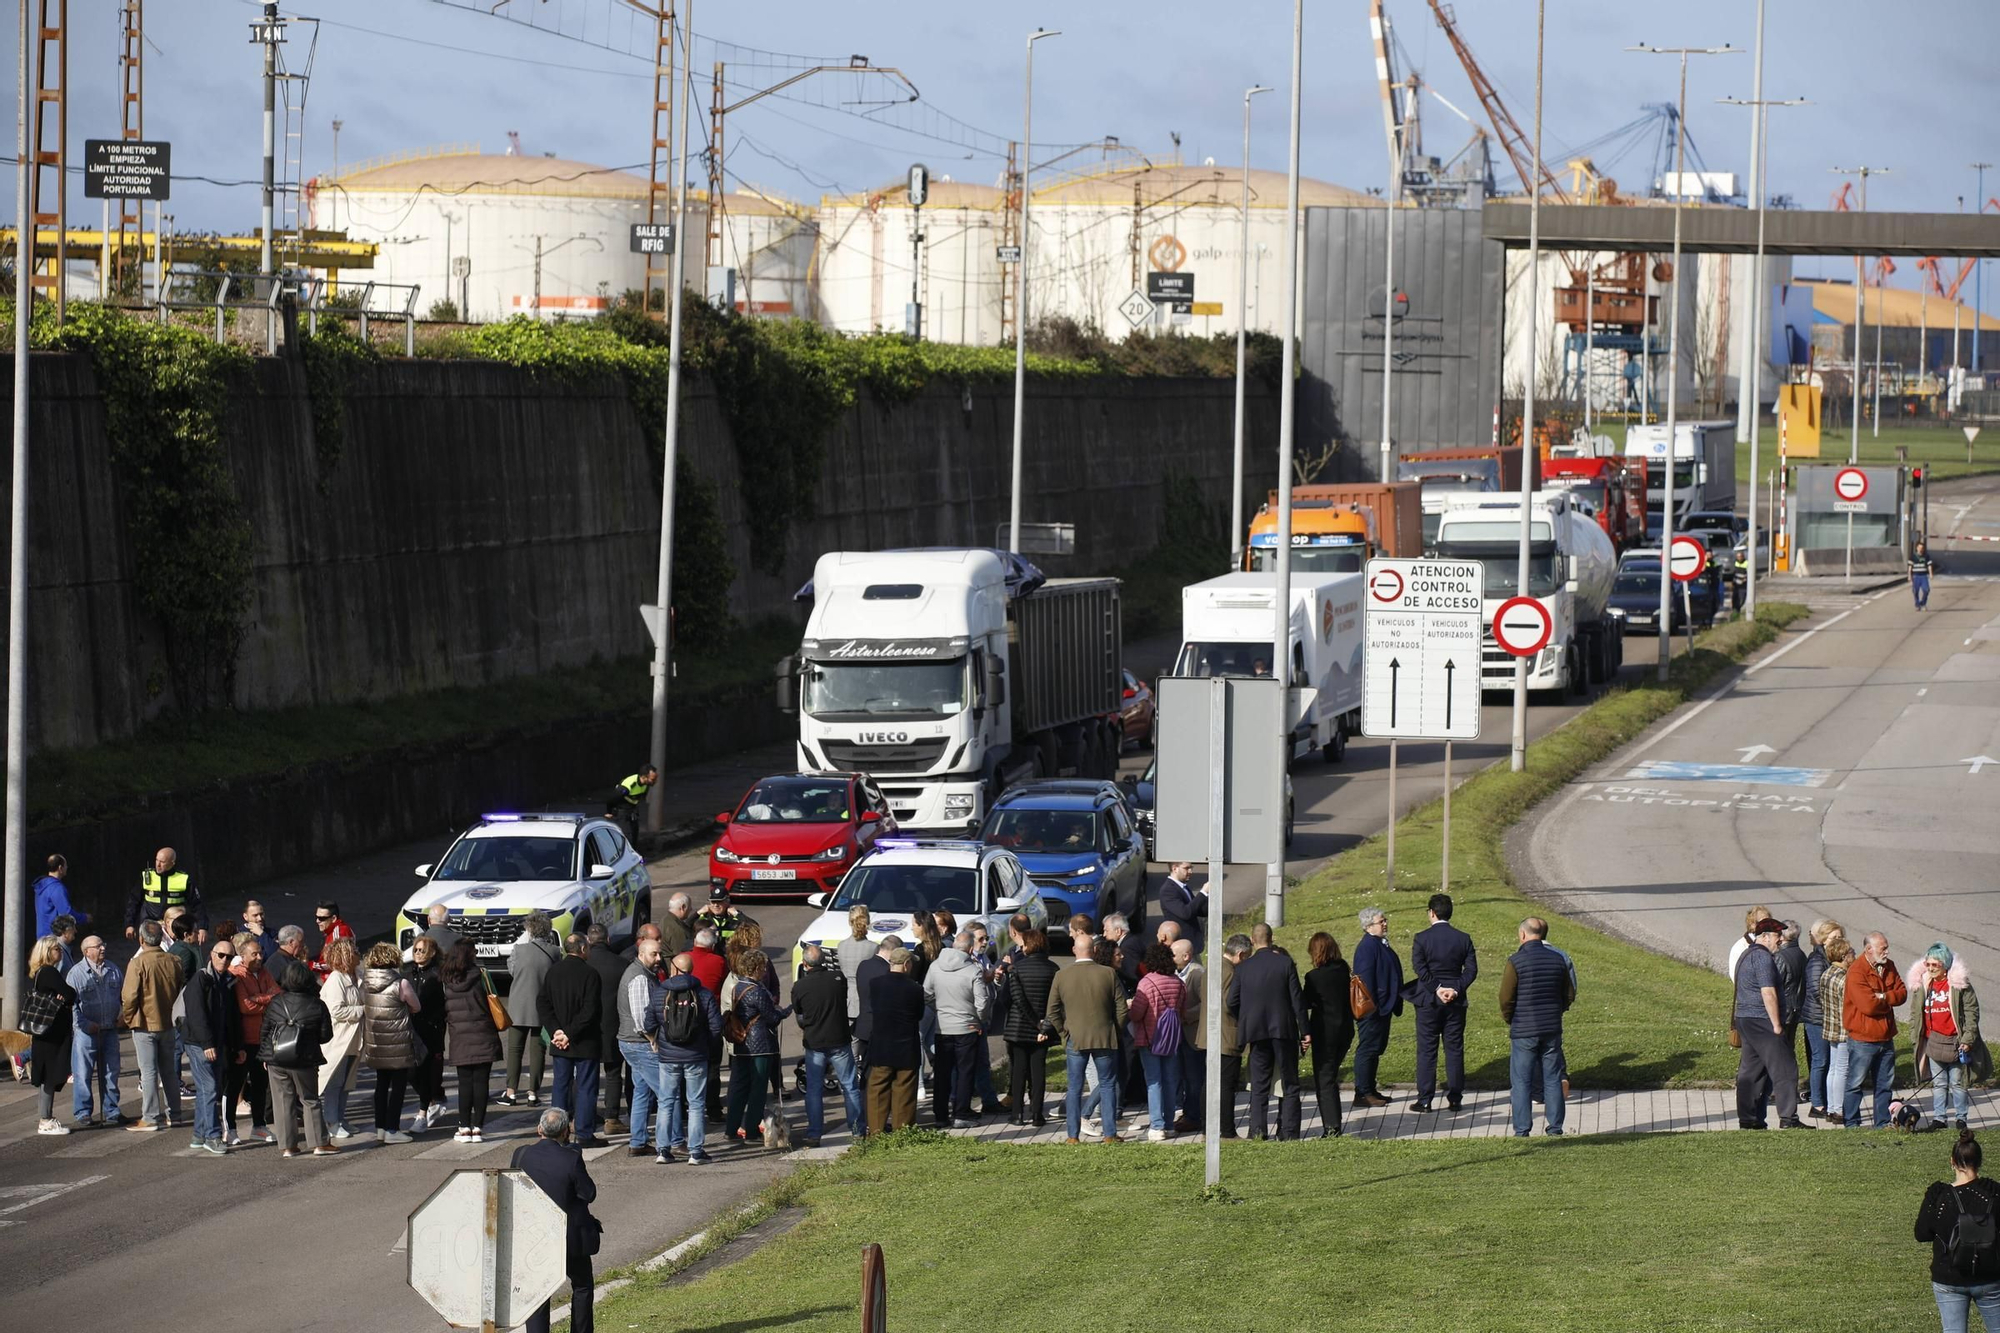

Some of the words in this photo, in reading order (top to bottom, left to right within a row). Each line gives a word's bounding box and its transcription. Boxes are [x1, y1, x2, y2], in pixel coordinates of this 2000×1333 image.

[99, 144, 105, 153] A
[107, 145, 120, 154] 100
[122, 146, 157, 155] METROS
[109, 155, 146, 165] EMPIEZA
[89, 163, 116, 173] LÍMITE
[117, 166, 165, 175] FUNCIONAL
[103, 176, 152, 185] AUTORIDAD
[103, 185, 151, 195] PORTUARIA
[636, 225, 657, 237] SALE
[659, 226, 670, 237] DE
[641, 238, 664, 252] RFIG
[1193, 246, 1222, 260] galp
[1128, 303, 1144, 316] 20
[1410, 566, 1475, 578] ATENCION
[1411, 581, 1472, 593] CONTROL
[1404, 596, 1420, 607] DE
[1426, 597, 1479, 609] ACCESO
[1377, 618, 1416, 627] VEHICULOS
[1431, 620, 1469, 628] VEHICULOS
[829, 640, 937, 658] Asturleonesa
[1371, 641, 1420, 649] AUTORIZADOS
[858, 732, 908, 743] IVECO
[1604, 786, 1683, 798] DEL
[1732, 793, 1814, 803] MAR
[1580, 794, 1816, 813] AUTOPISTA
[479, 946, 497, 955] MNK
